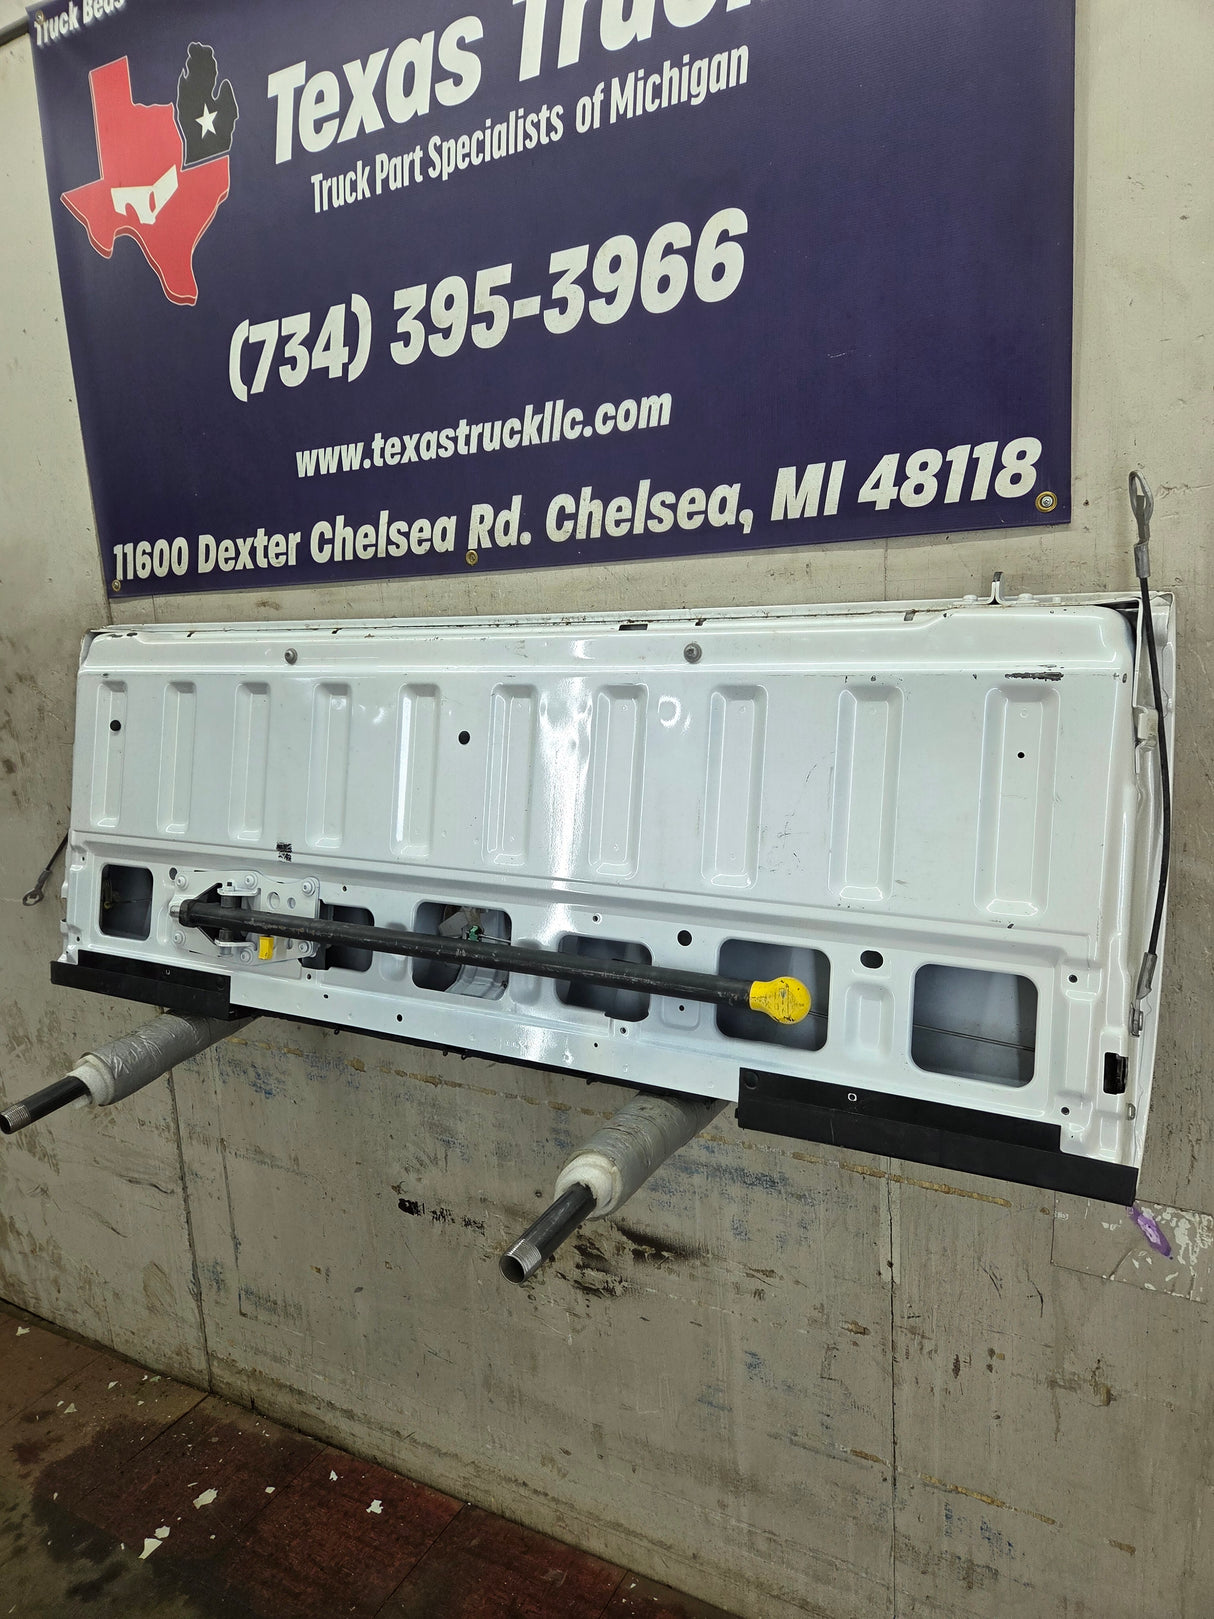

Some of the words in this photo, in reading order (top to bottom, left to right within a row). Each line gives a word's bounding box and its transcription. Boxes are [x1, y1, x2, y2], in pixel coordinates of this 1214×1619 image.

[34, 0, 80, 46] Truck
[266, 15, 484, 165] Texas
[511, 0, 752, 82] Tru
[310, 159, 372, 213] Truck
[375, 144, 424, 196] Part
[427, 103, 564, 182] Specialists
[575, 81, 605, 134] of
[609, 44, 749, 125] Michigan
[228, 293, 372, 403] (734)
[389, 207, 749, 366] 395-3966
[113, 534, 189, 581] 11600
[197, 527, 302, 574] Dexter
[310, 509, 457, 564] Chelsea
[467, 494, 532, 550] Rd.
[545, 478, 754, 543] Chelsea,
[770, 459, 847, 521] MI
[857, 436, 1043, 511] 48118
[295, 392, 673, 478] www.texastruckllc.com
